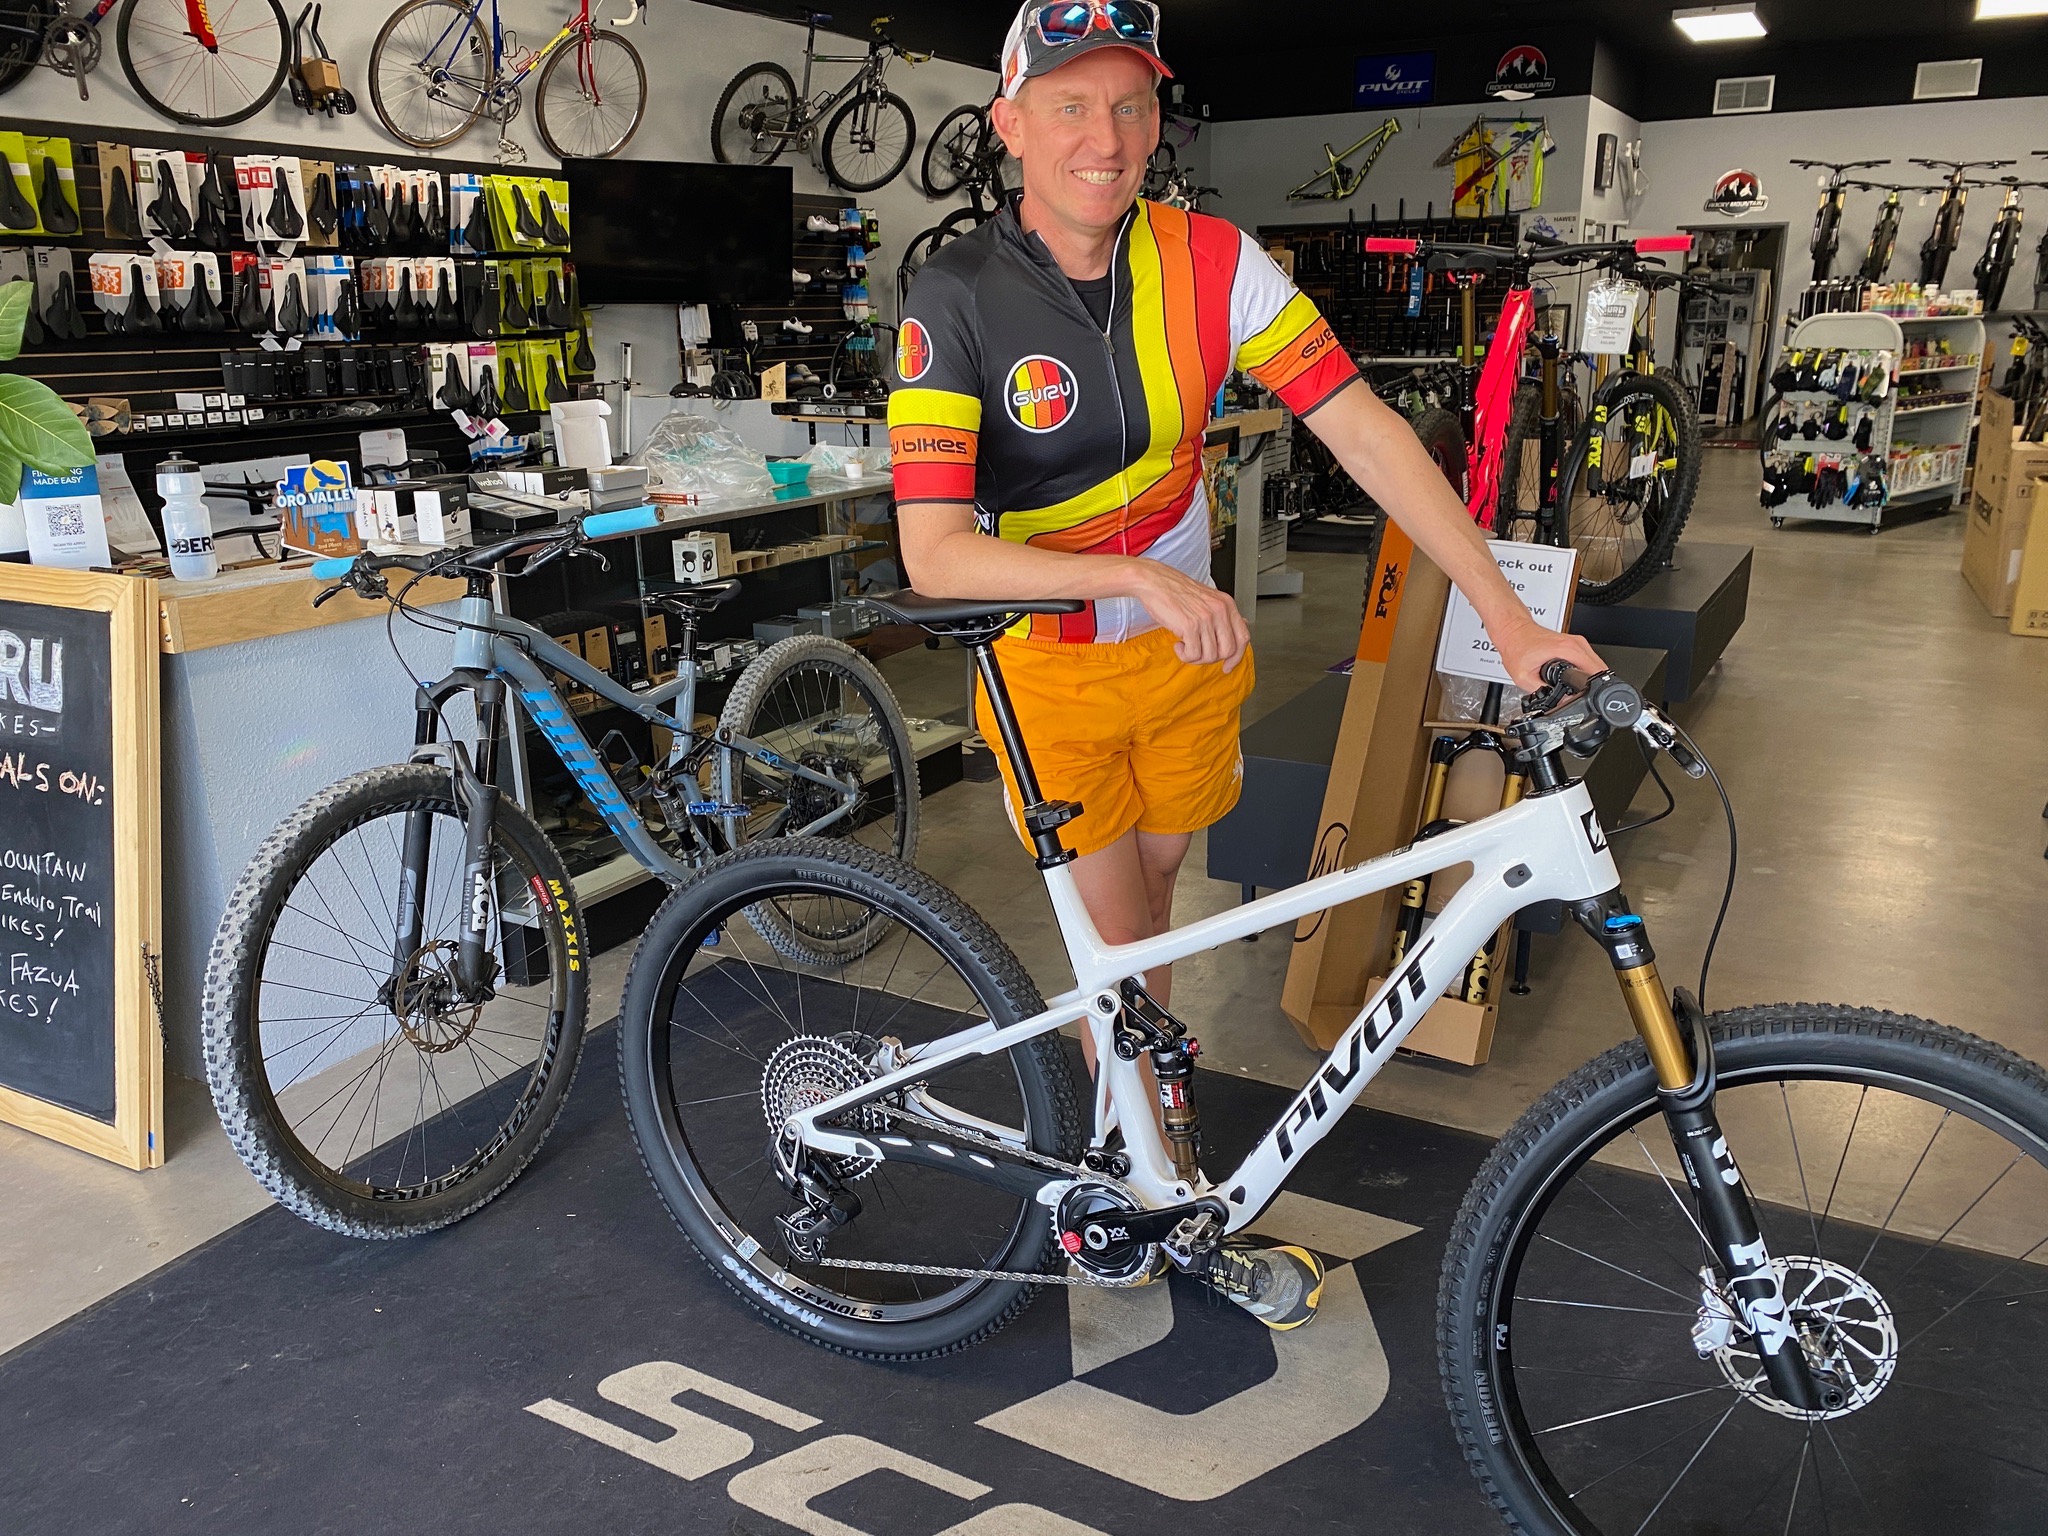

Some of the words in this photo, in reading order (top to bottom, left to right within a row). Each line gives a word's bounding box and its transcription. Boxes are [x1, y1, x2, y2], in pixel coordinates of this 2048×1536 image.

[197, 0, 214, 35] URU
[1358, 79, 1429, 93] PIVOT
[1488, 83, 1513, 92] ROCKY
[1514, 81, 1553, 90] MOUNTAIN
[1553, 215, 1577, 223] HAWES
[1604, 305, 1626, 314] URU
[898, 344, 928, 359] GURU
[1301, 328, 1336, 360] GUR
[1012, 380, 1072, 408] GURU
[33, 477, 60, 486] MADE
[477, 475, 504, 488] wahoo
[557, 474, 574, 483] wahoo
[276, 493, 307, 509] ORO
[307, 486, 358, 506] VALLEY
[177, 536, 216, 554] BER
[1498, 558, 1524, 570] eck
[1528, 562, 1554, 574] out
[1375, 563, 1403, 618] FOX
[1508, 579, 1526, 592] he
[1527, 606, 1546, 616] ew
[1471, 639, 1498, 653] 202
[654, 709, 669, 721] JET
[58, 769, 106, 806] ON:
[0, 849, 87, 884] OUNTAIN
[796, 868, 849, 887] REKON
[851, 879, 895, 906] RACE
[61, 895, 101, 928] Trail
[462, 879, 472, 925] RHYTHM
[471, 872, 491, 932] FOX
[547, 879, 581, 973] MAXXIS
[1467, 948, 1494, 1004] FOX
[1276, 936, 1435, 1163] PIVOT
[1161, 1083, 1175, 1109] FOX
[1107, 1226, 1129, 1238] XX
[1485, 1247, 1498, 1267] EXO
[722, 1254, 824, 1327] MAXXIS
[1729, 1231, 1800, 1356] FOX
[1474, 1369, 1504, 1446] REKON
